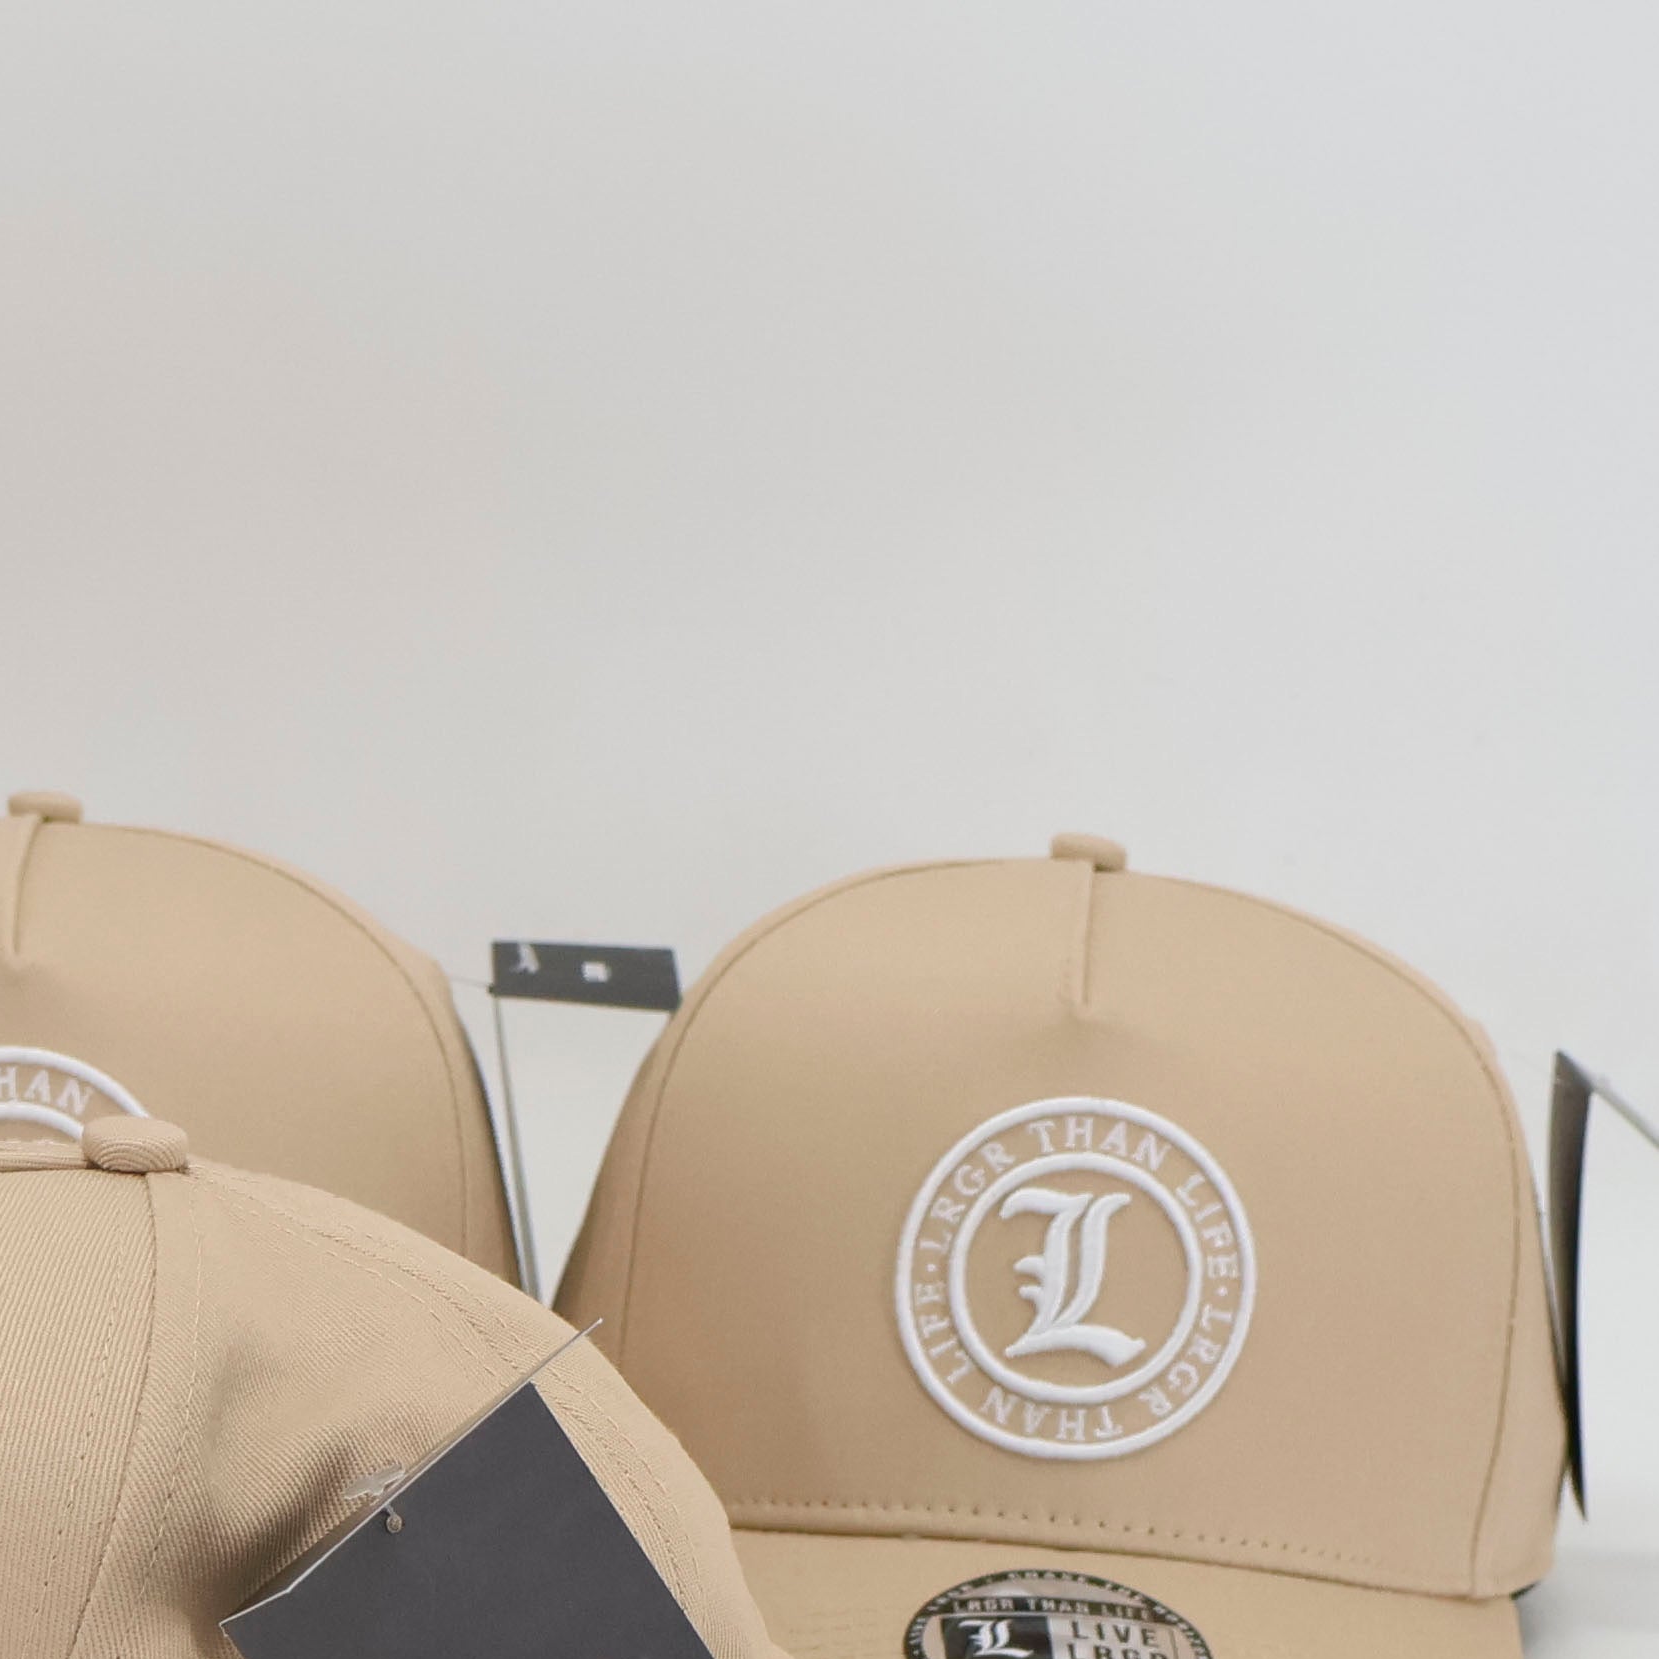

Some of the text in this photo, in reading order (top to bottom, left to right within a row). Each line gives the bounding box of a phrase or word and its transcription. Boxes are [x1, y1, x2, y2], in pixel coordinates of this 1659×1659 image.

[920, 1115, 1239, 1279] LRGR THAN LIFE
[915, 1283, 1233, 1441] LRGR THAN LIFE
[1071, 1620, 1160, 1648] LIVE
